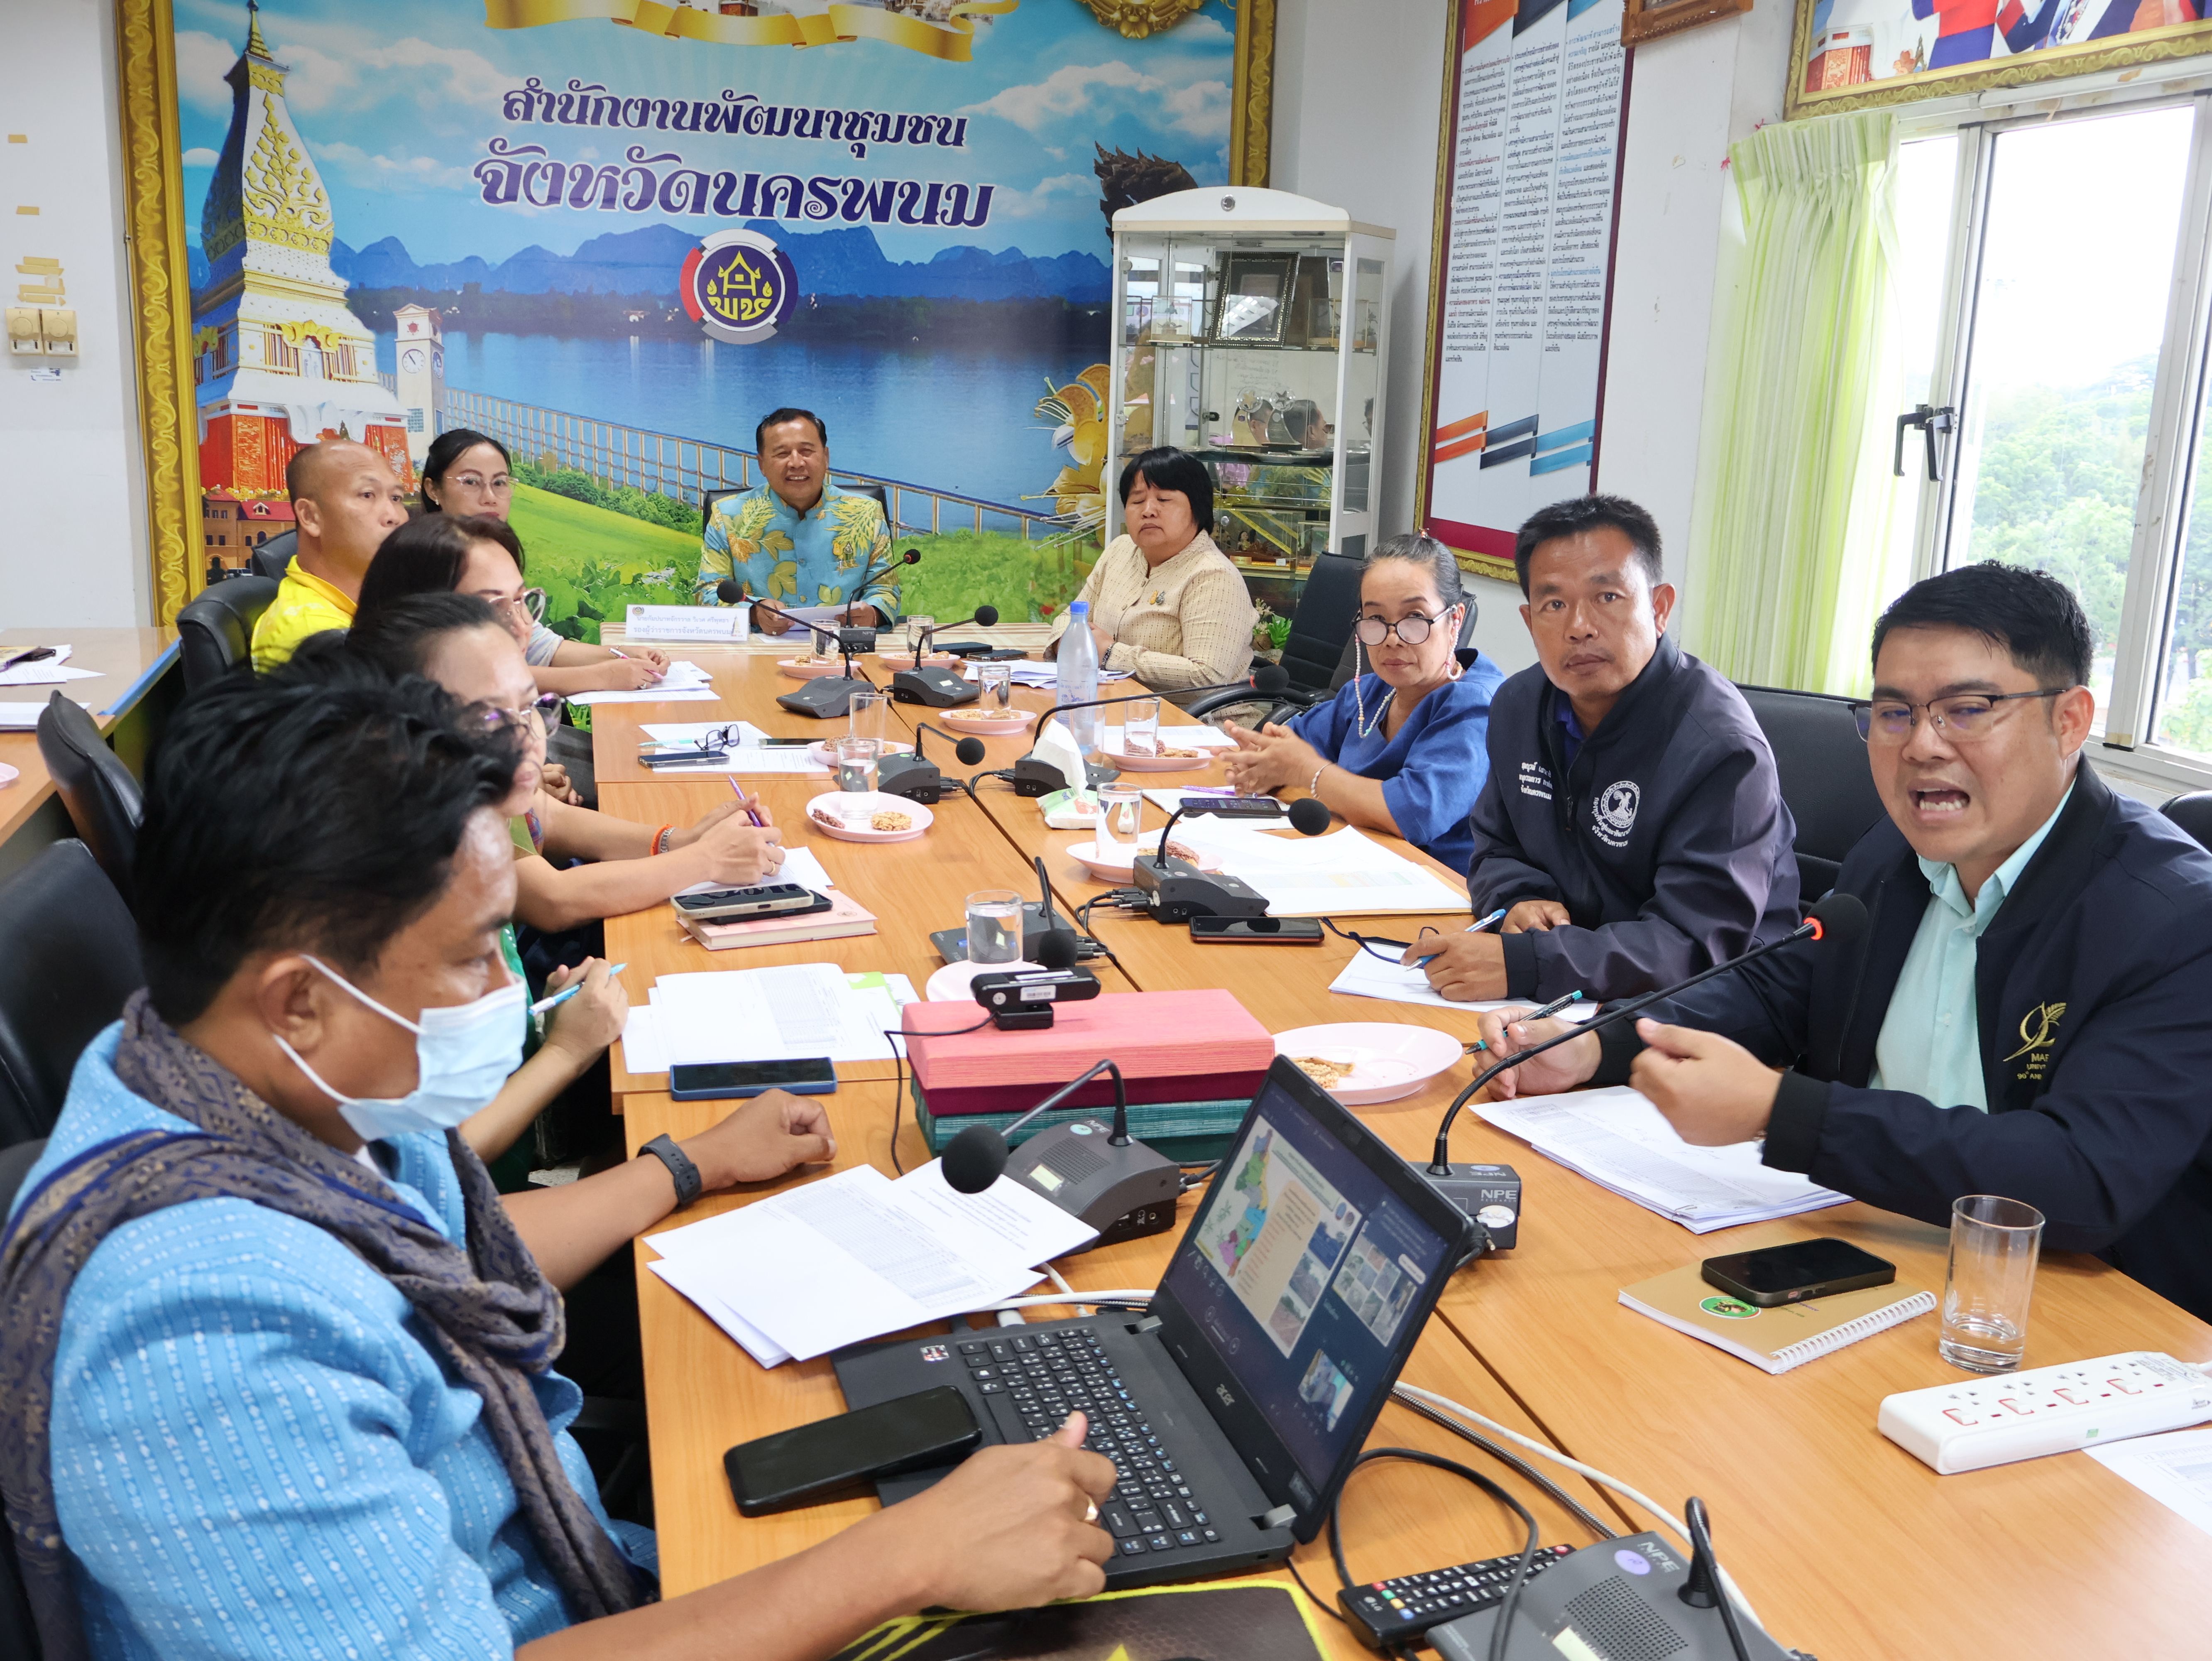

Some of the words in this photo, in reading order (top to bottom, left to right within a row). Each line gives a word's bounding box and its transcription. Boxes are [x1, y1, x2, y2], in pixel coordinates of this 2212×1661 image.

[503, 78, 969, 158] สำนักงานพัฒนาชุมชน
[475, 138, 995, 228] จังหวัดนครพนม
[1480, 1189, 1517, 1199] NPE
[1637, 1541, 1680, 1573] NPE
